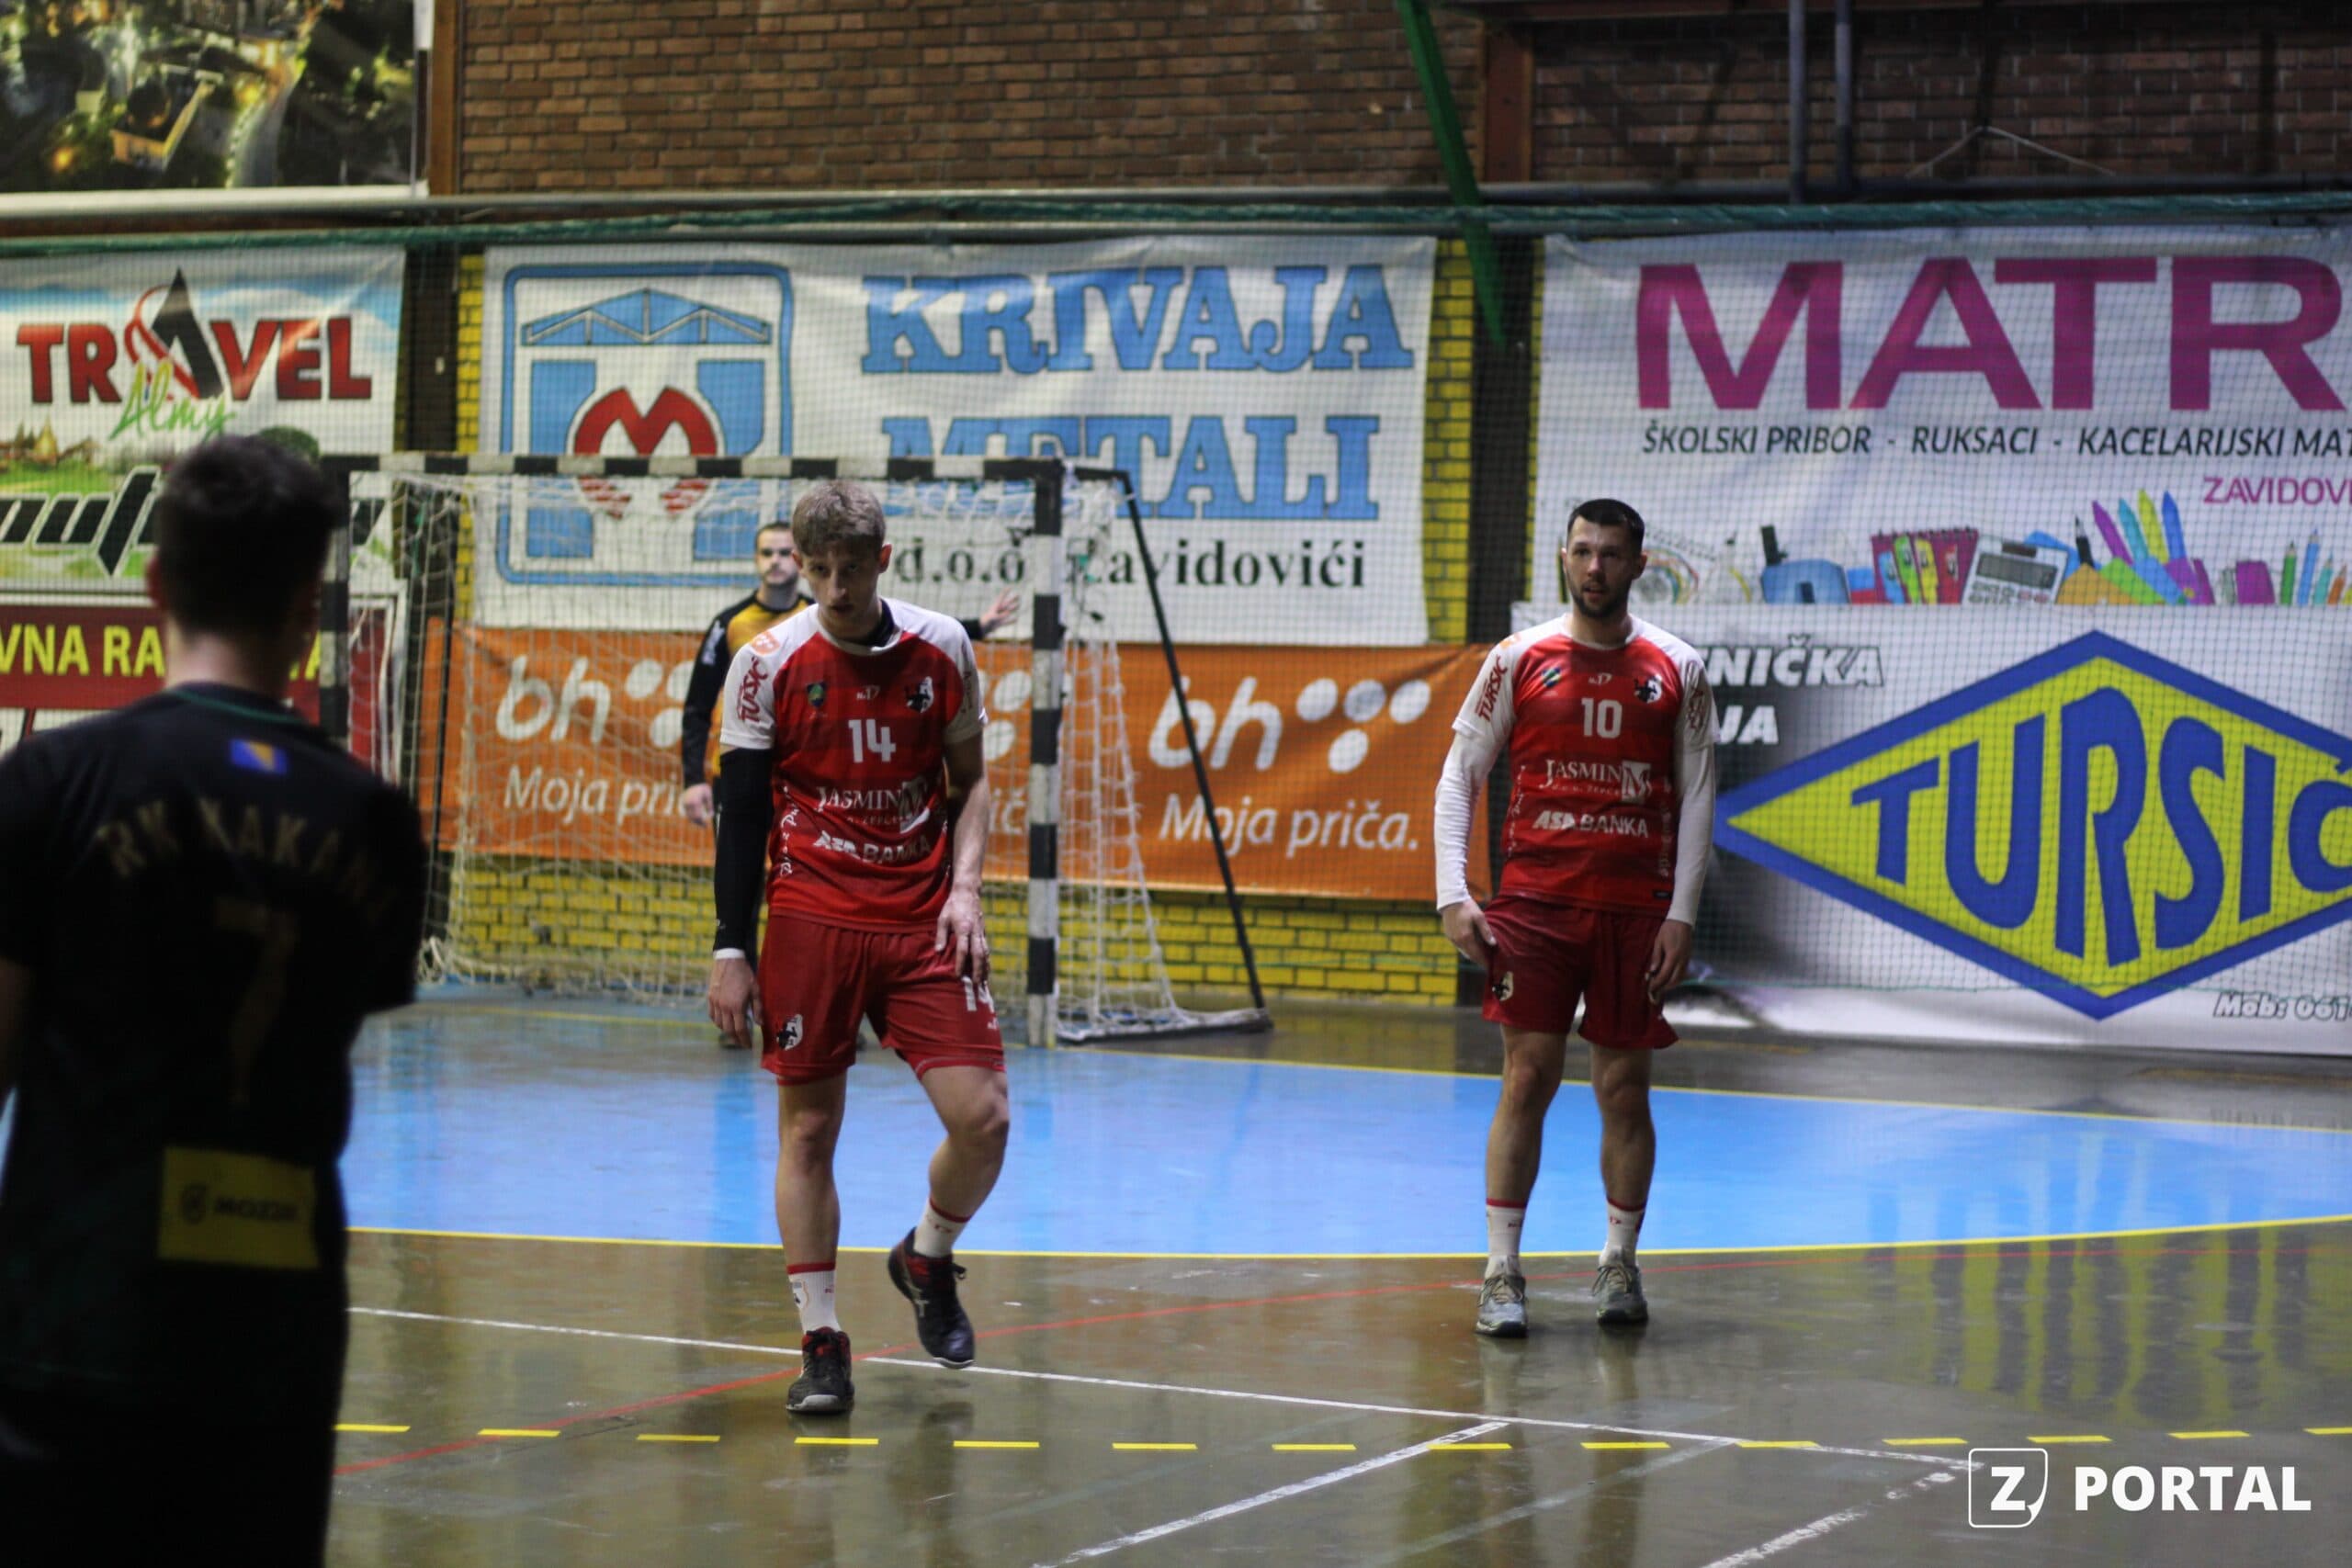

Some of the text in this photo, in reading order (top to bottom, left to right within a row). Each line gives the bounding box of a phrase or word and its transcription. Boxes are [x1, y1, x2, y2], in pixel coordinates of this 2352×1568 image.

[860, 264, 1415, 375] KRIVAJA
[1636, 255, 2347, 412] MATR
[1642, 419, 1758, 455] ŠKOLSKI
[1765, 425, 1871, 454] PRIBOR
[1911, 425, 2040, 455] RUKSACI
[2077, 426, 2284, 457] KACELARIJSKI
[1696, 634, 1883, 687] NIČKA
[495, 654, 611, 741] bh
[1148, 676, 1283, 771] bh
[1581, 697, 1623, 739] 10
[848, 718, 897, 764] 14
[504, 764, 607, 825] Moja
[1538, 759, 1623, 790] JASMIN
[1159, 793, 1419, 860] Moja priča.
[1579, 814, 1649, 838] BANKA
[2212, 990, 2352, 1022] Mob: 061
